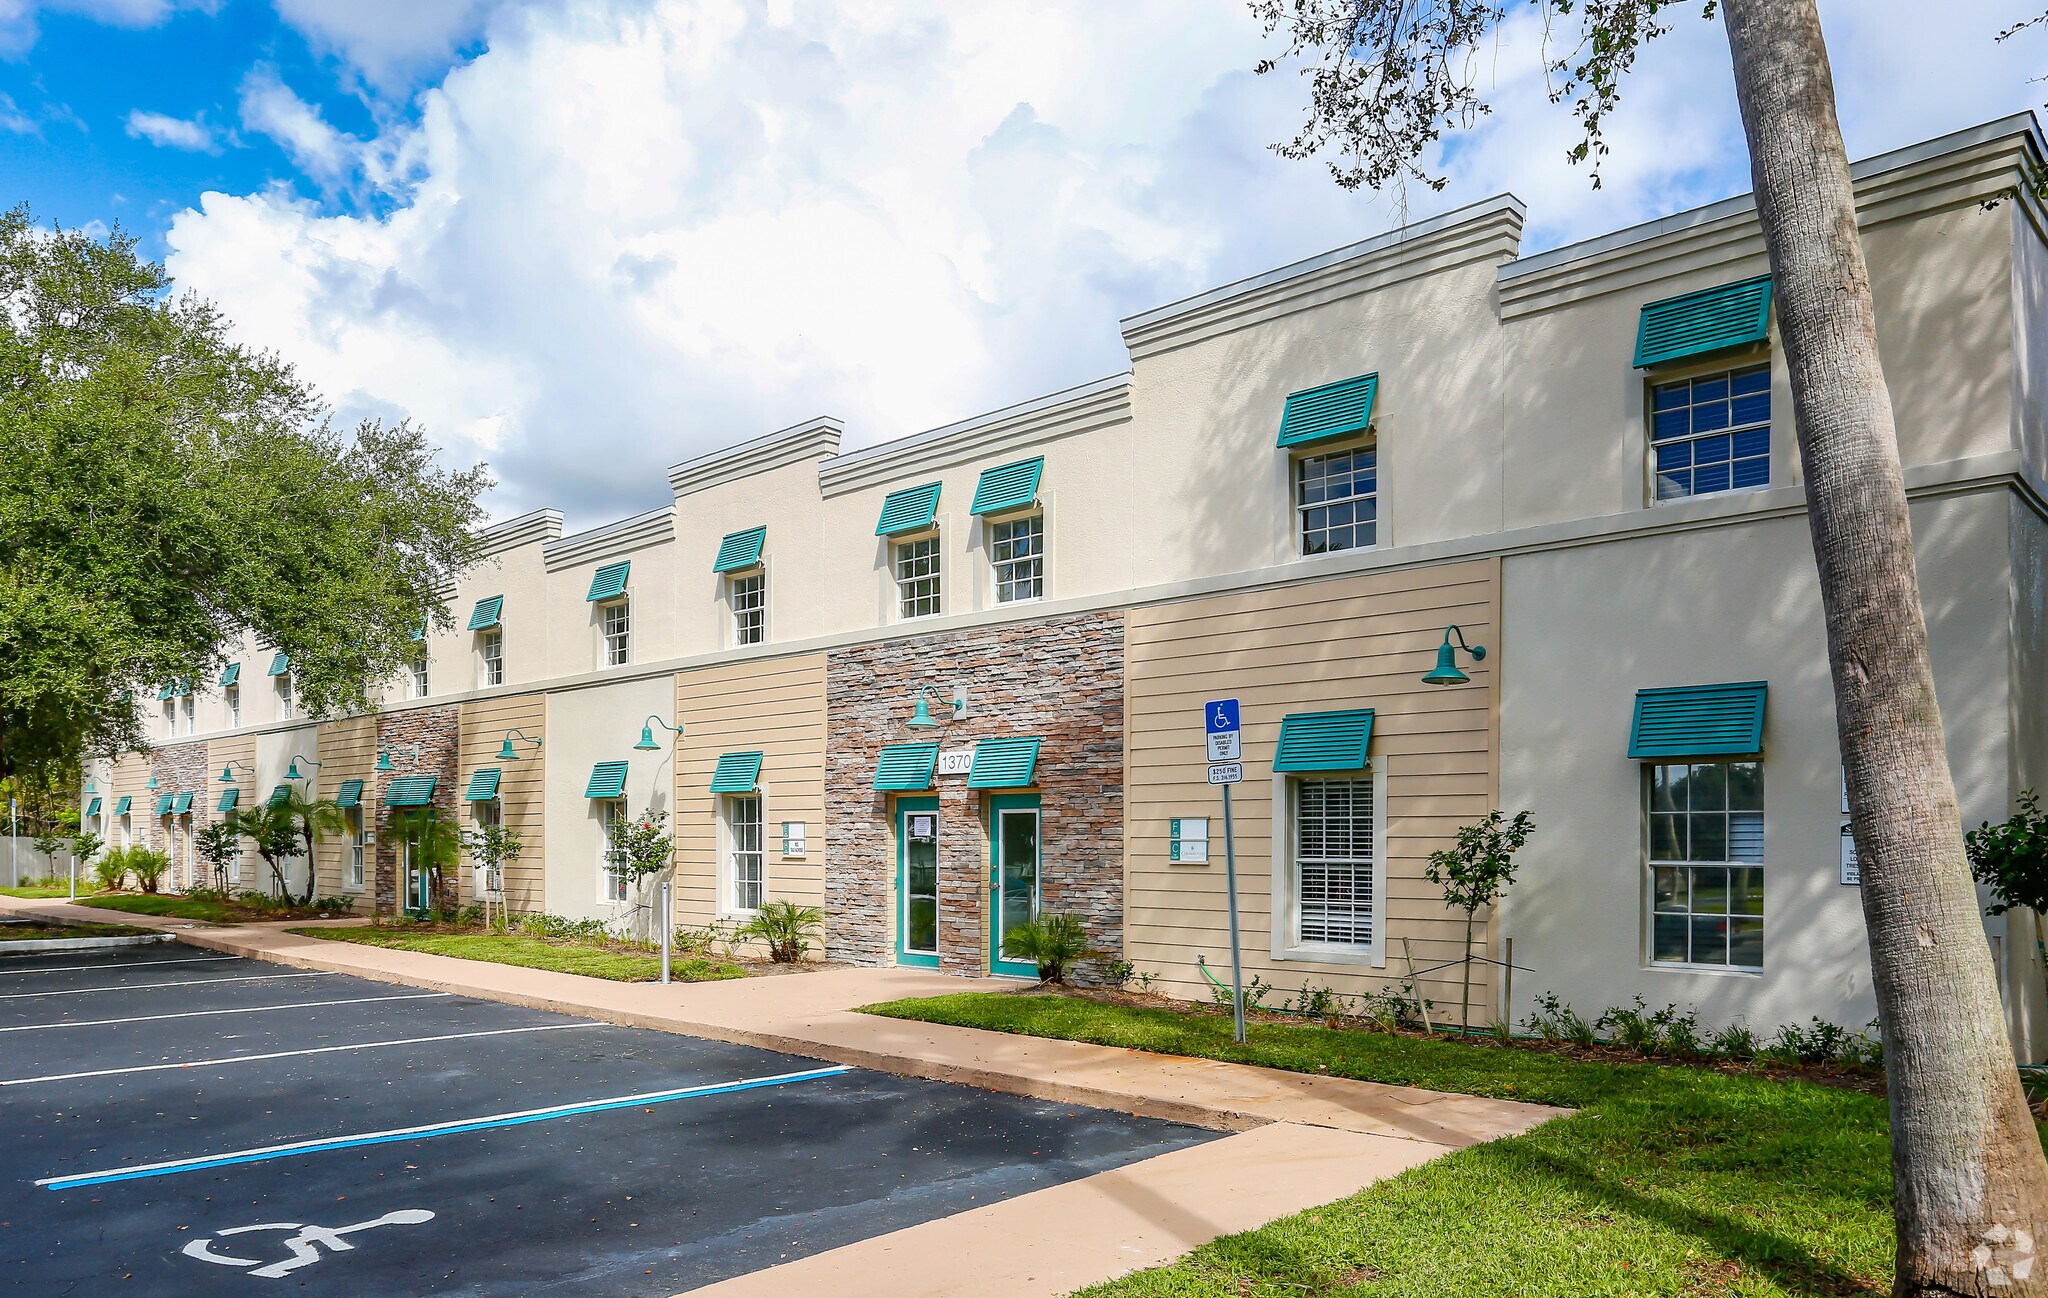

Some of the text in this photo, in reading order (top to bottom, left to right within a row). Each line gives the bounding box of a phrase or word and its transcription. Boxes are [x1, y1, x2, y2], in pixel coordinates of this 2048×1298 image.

[942, 755, 971, 770] 1370
[1212, 767, 1226, 775] $250
[1172, 821, 1179, 830] F
[1172, 843, 1179, 853] C
